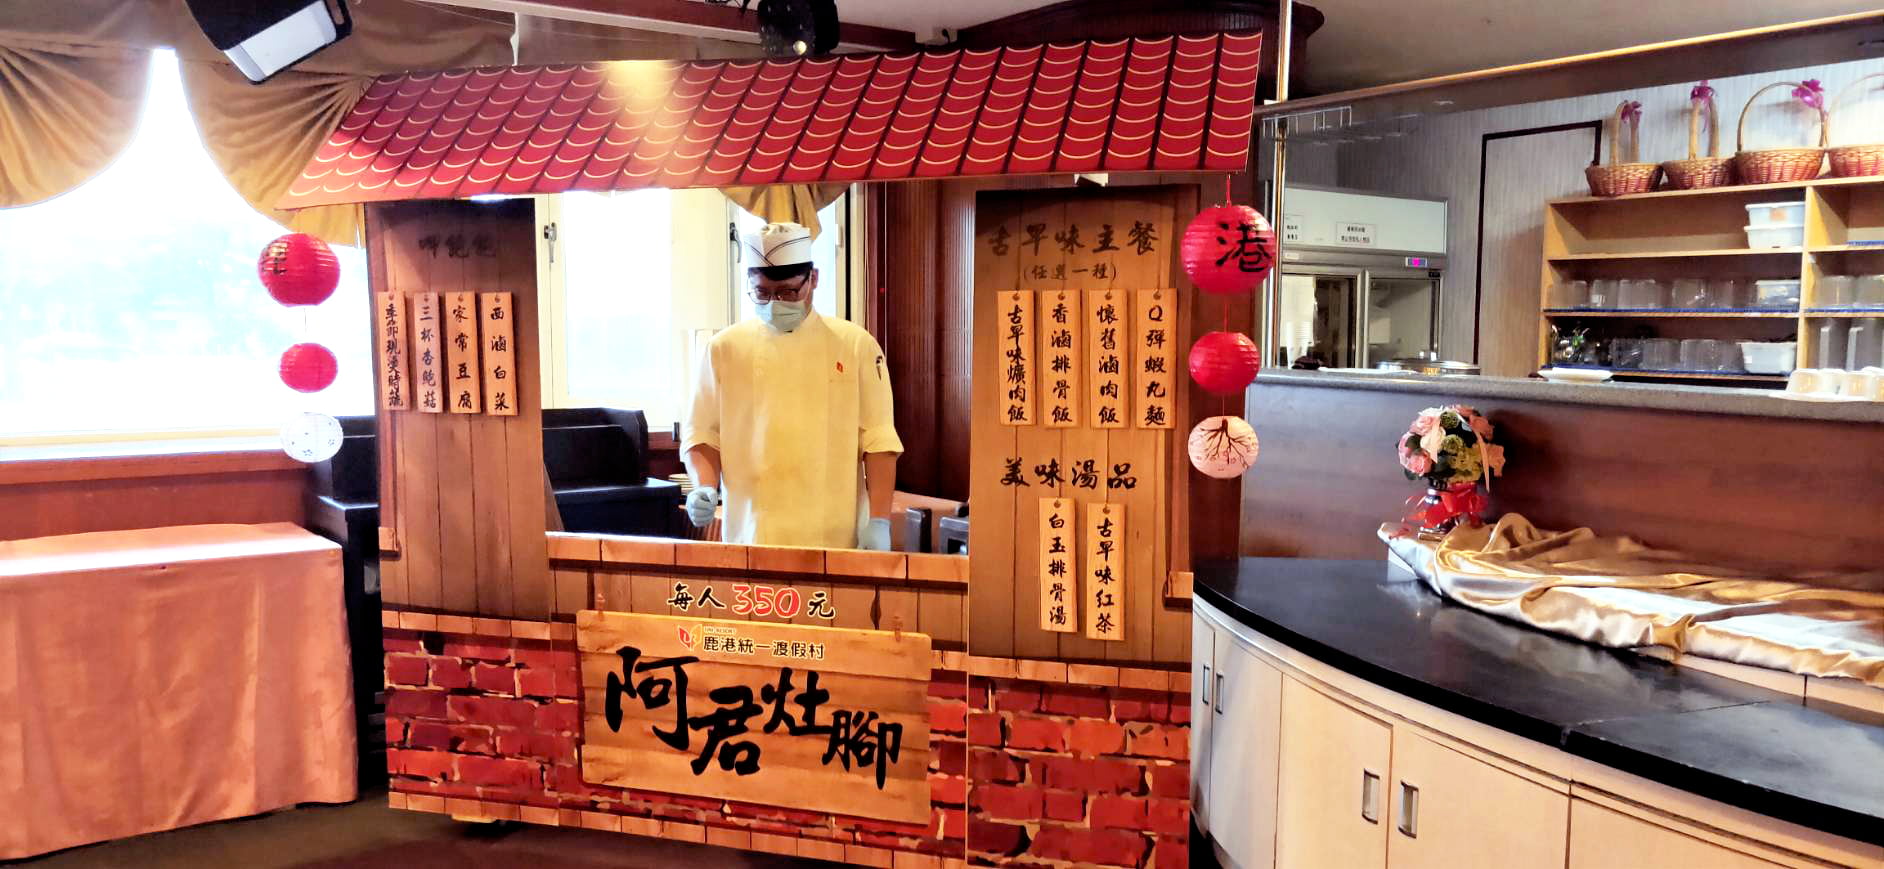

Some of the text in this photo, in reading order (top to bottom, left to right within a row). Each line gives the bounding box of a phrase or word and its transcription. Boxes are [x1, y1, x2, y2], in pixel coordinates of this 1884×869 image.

[988, 220, 1160, 256] 古早味主餐
[1216, 221, 1273, 273] 港
[420, 305, 437, 408] 三杯杏鮑菇
[452, 305, 473, 409] 家常豆腐
[490, 307, 510, 410] 西滷白菜
[1050, 303, 1073, 424] 香滷排骨飯
[1096, 304, 1120, 424] 懷舊滷肉飯
[1144, 306, 1167, 426] Q彈蝦丸麵
[1000, 457, 1137, 490] 美味湯品
[1048, 513, 1067, 626] 白玉排骨湯
[1095, 517, 1115, 634] 古早味紅茶
[703, 636, 825, 660] 鹿港統一渡假村
[604, 645, 904, 791] 阿君灶腳
